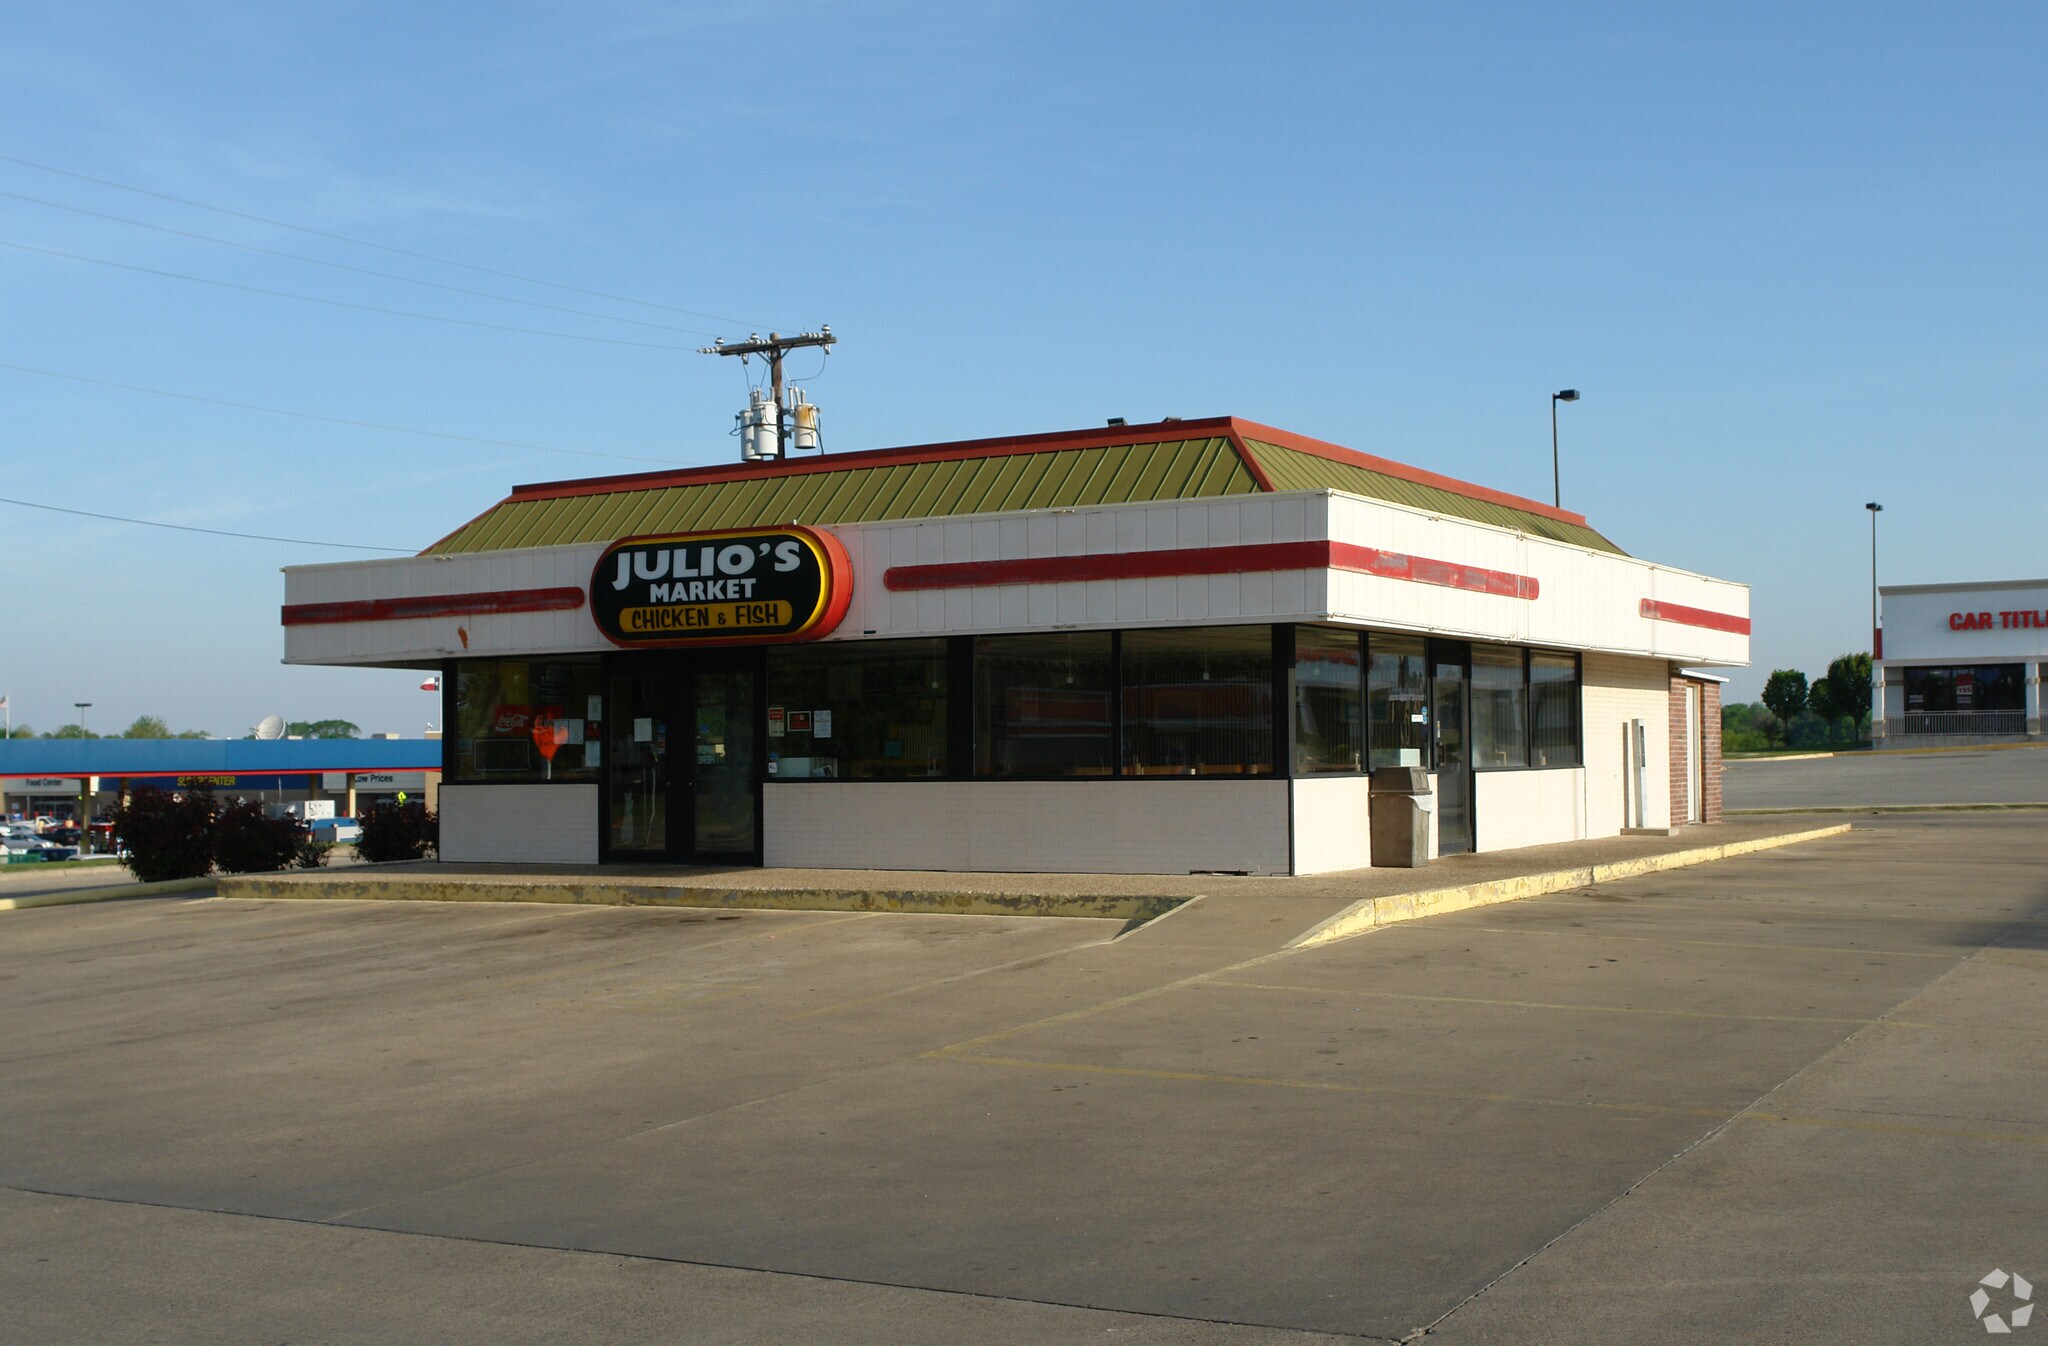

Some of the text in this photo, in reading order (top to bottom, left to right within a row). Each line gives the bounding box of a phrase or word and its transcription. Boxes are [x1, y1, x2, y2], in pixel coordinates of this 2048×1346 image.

[611, 541, 801, 591] JULIO'S
[650, 577, 757, 603] MARKET
[631, 604, 779, 629] CHICKEN & FISH
[1949, 610, 2048, 631] CAR TITL
[43, 778, 63, 786] Center
[177, 776, 236, 786] SUPRENTER
[370, 773, 393, 782] Prices
